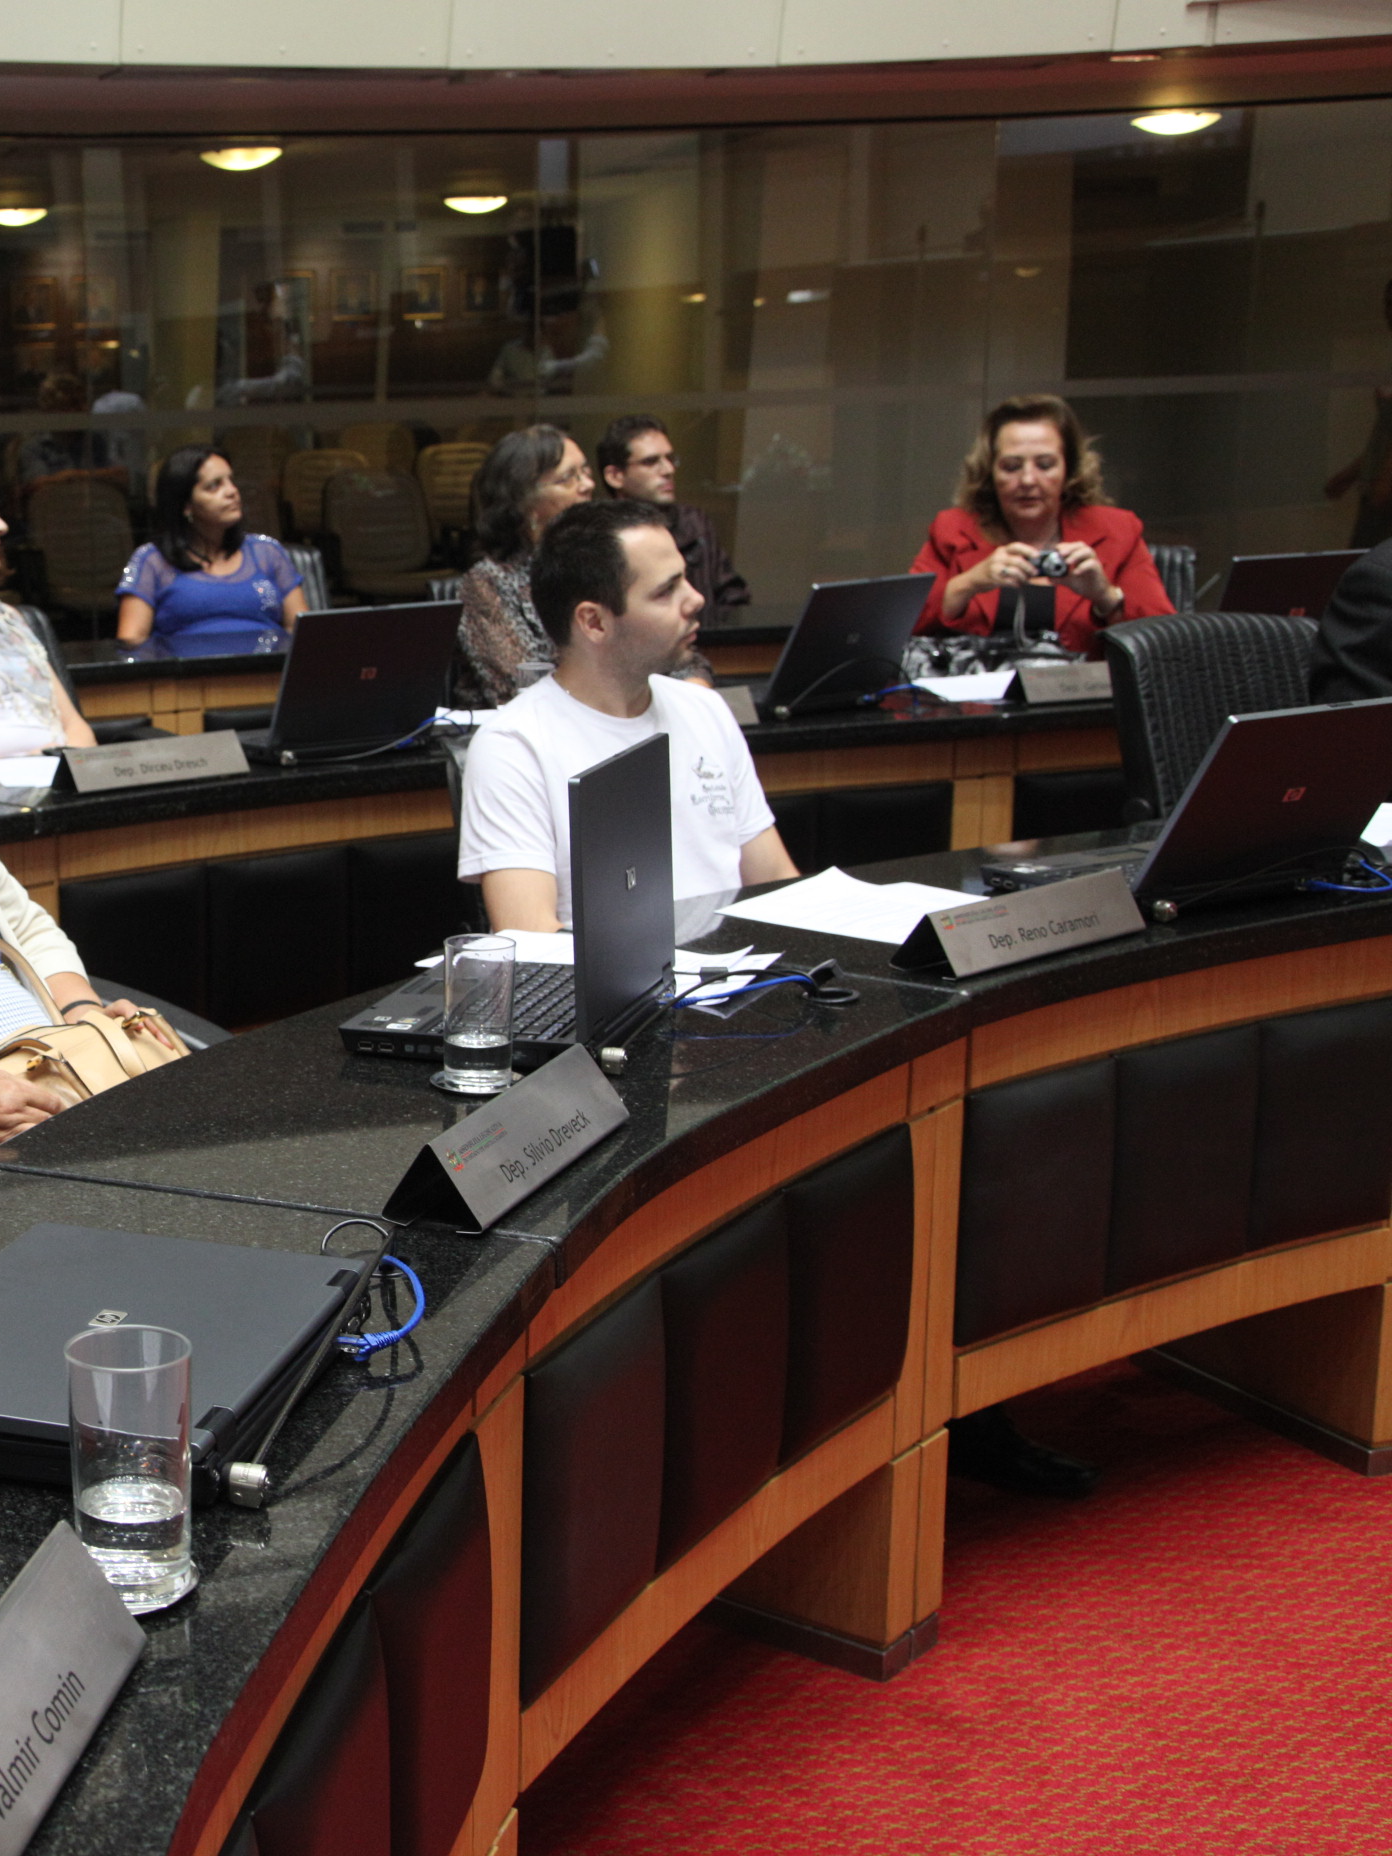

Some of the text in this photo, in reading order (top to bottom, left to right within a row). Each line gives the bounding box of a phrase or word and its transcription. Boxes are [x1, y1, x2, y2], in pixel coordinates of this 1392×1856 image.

[988, 912, 1101, 950] Dep. Reno Caramori
[499, 1163, 529, 1183] Dep.
[523, 1138, 554, 1166] Silvio
[549, 1109, 591, 1147] Dreveck
[31, 1670, 86, 1744] Comin
